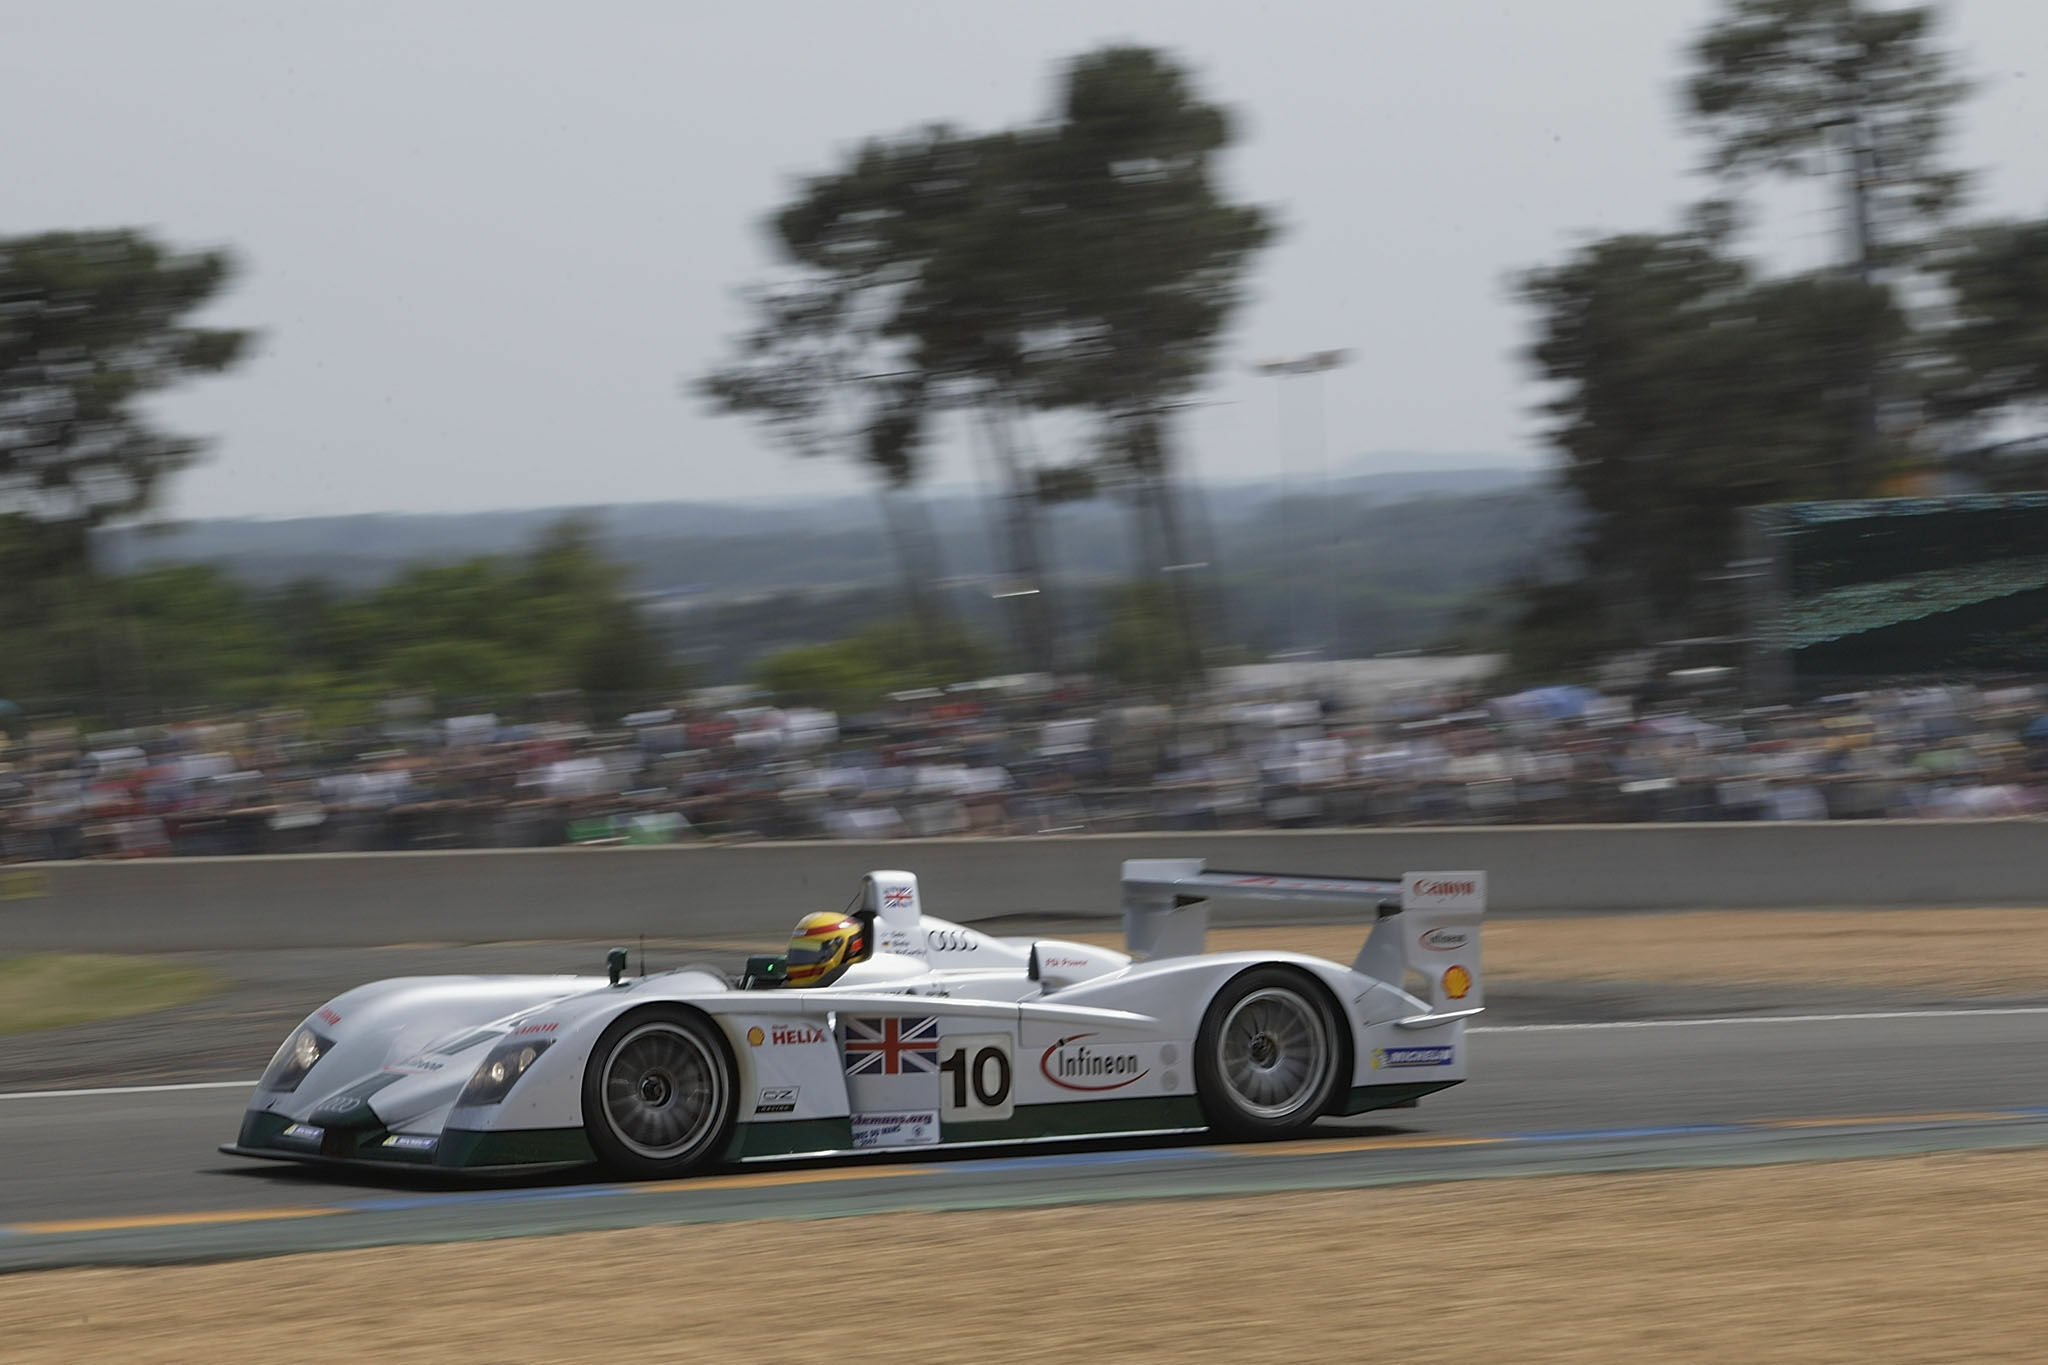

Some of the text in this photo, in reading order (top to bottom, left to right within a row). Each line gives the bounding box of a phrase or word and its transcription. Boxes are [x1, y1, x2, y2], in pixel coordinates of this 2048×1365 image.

[1413, 879, 1475, 896] Canon
[772, 1029, 828, 1045] HELIX
[1058, 1047, 1138, 1077] Infineon
[941, 1046, 1010, 1108] 10
